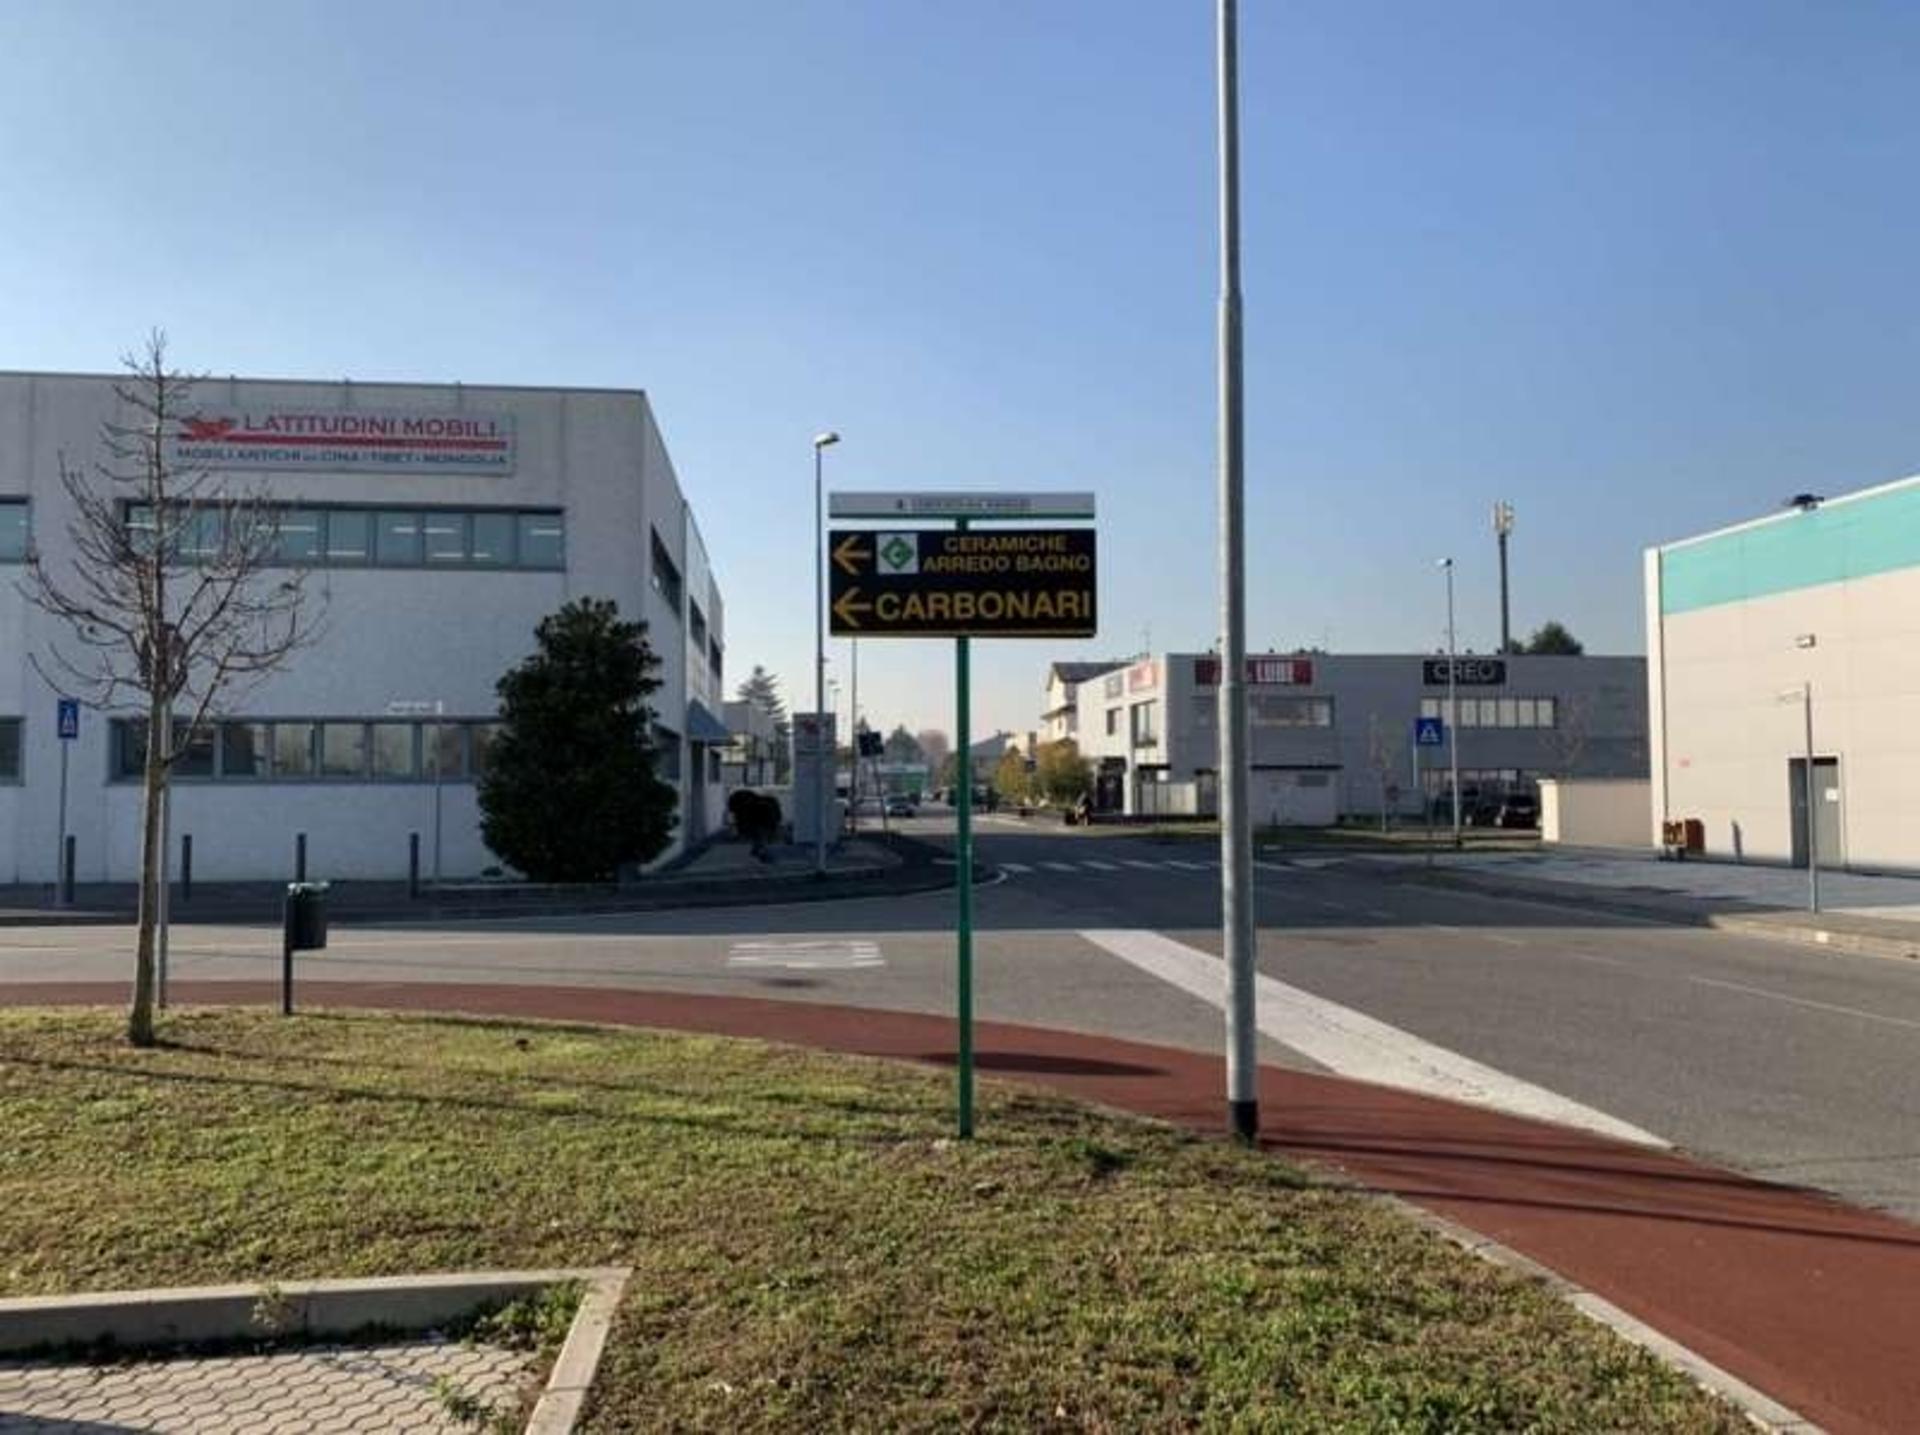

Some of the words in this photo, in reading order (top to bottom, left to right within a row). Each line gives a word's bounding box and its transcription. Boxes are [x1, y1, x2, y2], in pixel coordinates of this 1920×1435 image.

[244, 414, 396, 434] LATITUDINI
[402, 417, 496, 437] MOBILI
[943, 535, 1068, 552] CERAMICHE
[923, 555, 1010, 573] ARREDO
[1015, 554, 1091, 572] BAGNO
[875, 590, 1091, 621] CARBONARI
